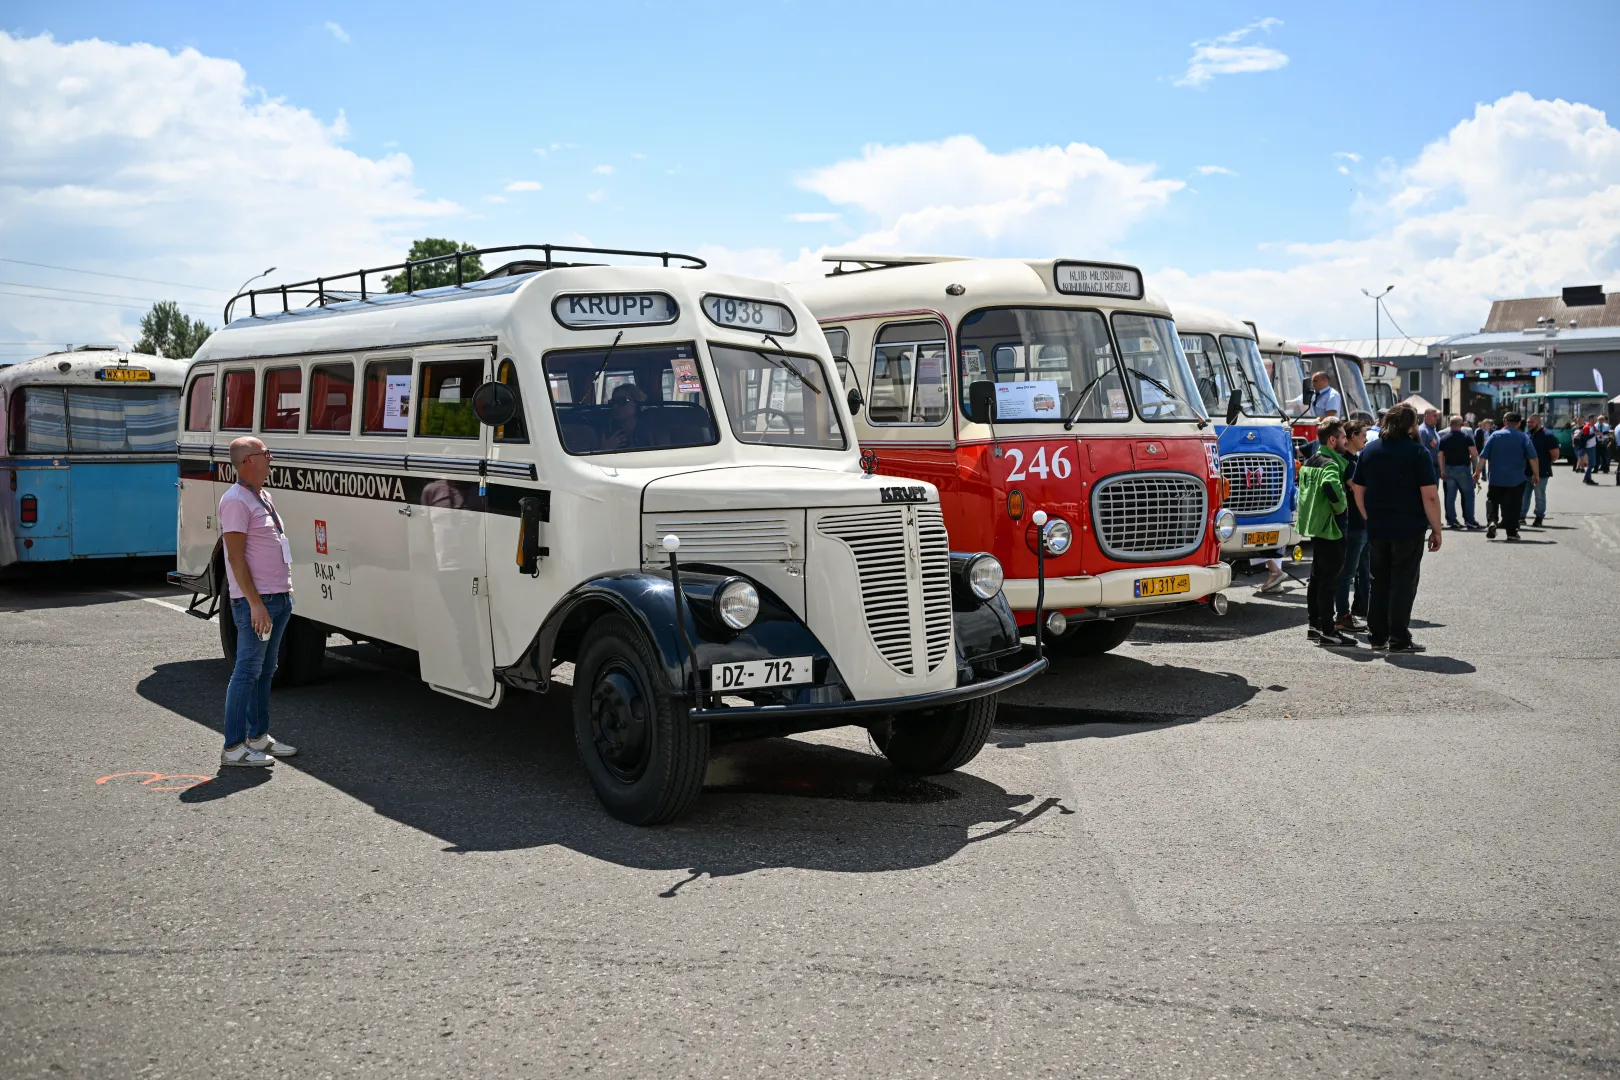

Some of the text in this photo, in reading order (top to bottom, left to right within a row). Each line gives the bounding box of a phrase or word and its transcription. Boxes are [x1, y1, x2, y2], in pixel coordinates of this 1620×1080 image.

[569, 295, 654, 316] KRUPP
[712, 298, 764, 324] 1938
[1004, 445, 1072, 482] 246
[218, 463, 406, 501] KOMACJA SAMOCHODOWA
[879, 486, 928, 503] KRUPP
[321, 583, 333, 601] 91
[1141, 577, 1176, 595] WJ 31Y
[764, 660, 792, 684] 712
